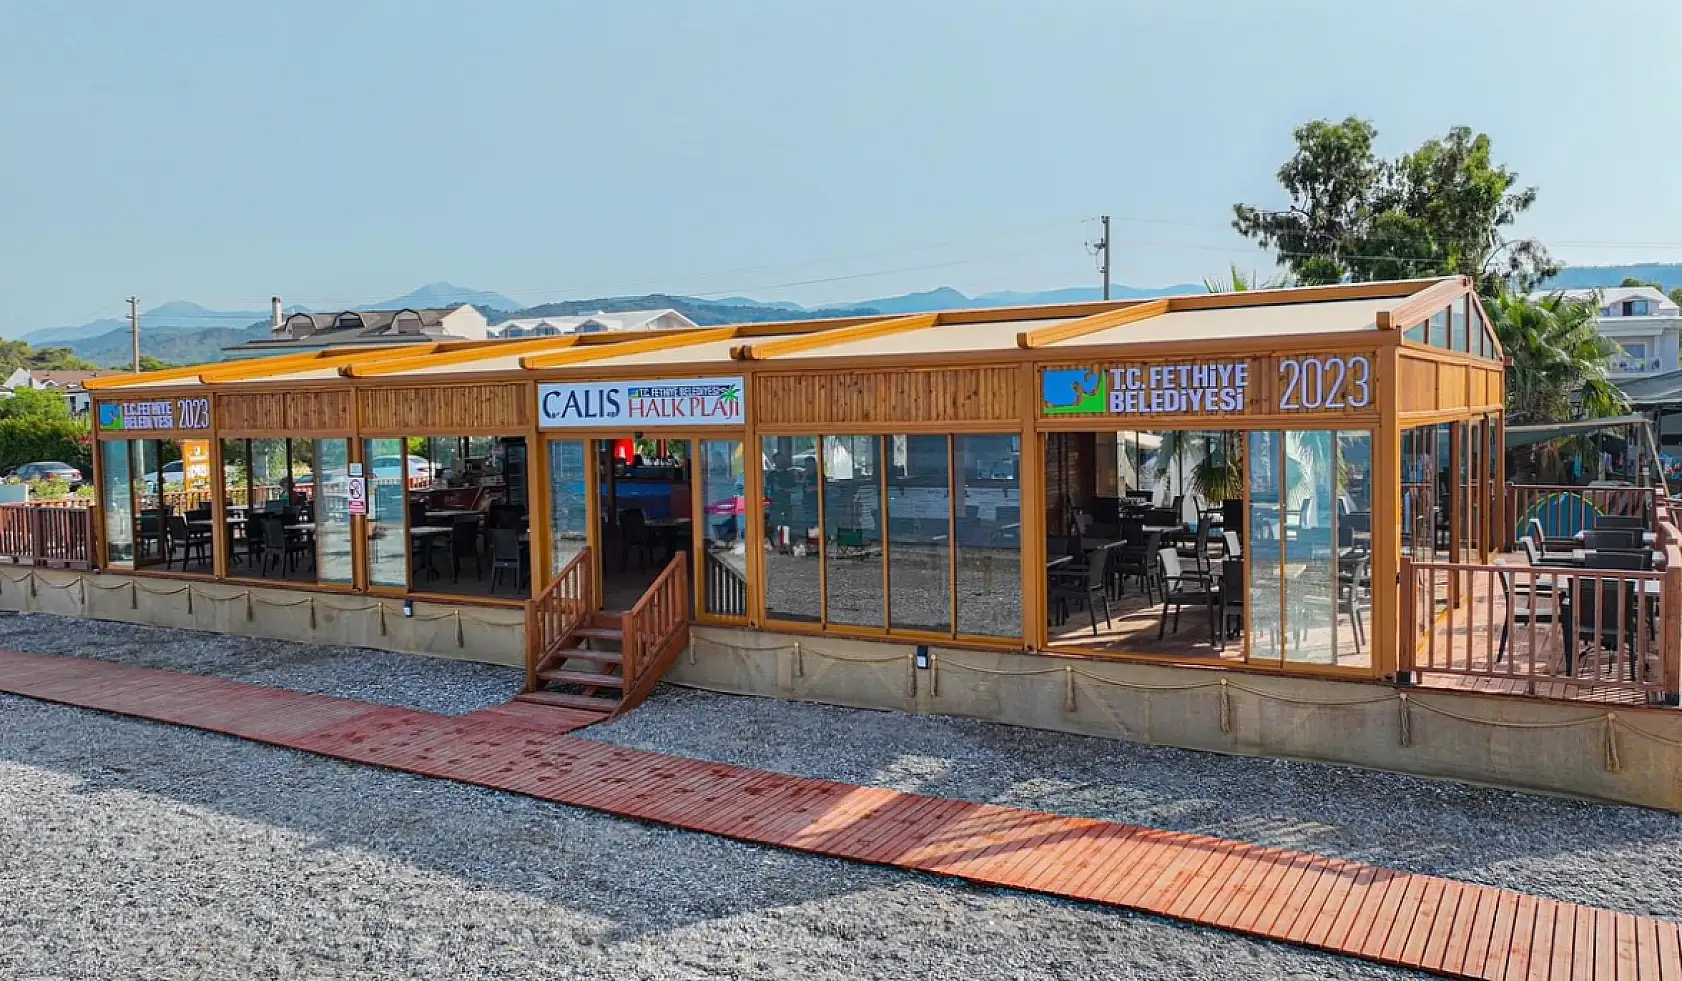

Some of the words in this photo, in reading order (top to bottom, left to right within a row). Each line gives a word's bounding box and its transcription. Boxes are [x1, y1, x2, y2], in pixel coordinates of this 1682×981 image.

[1109, 368, 1146, 390] T.C.
[1279, 356, 1371, 410] 2023
[178, 398, 210, 429] 2023
[628, 397, 685, 418] HALK
